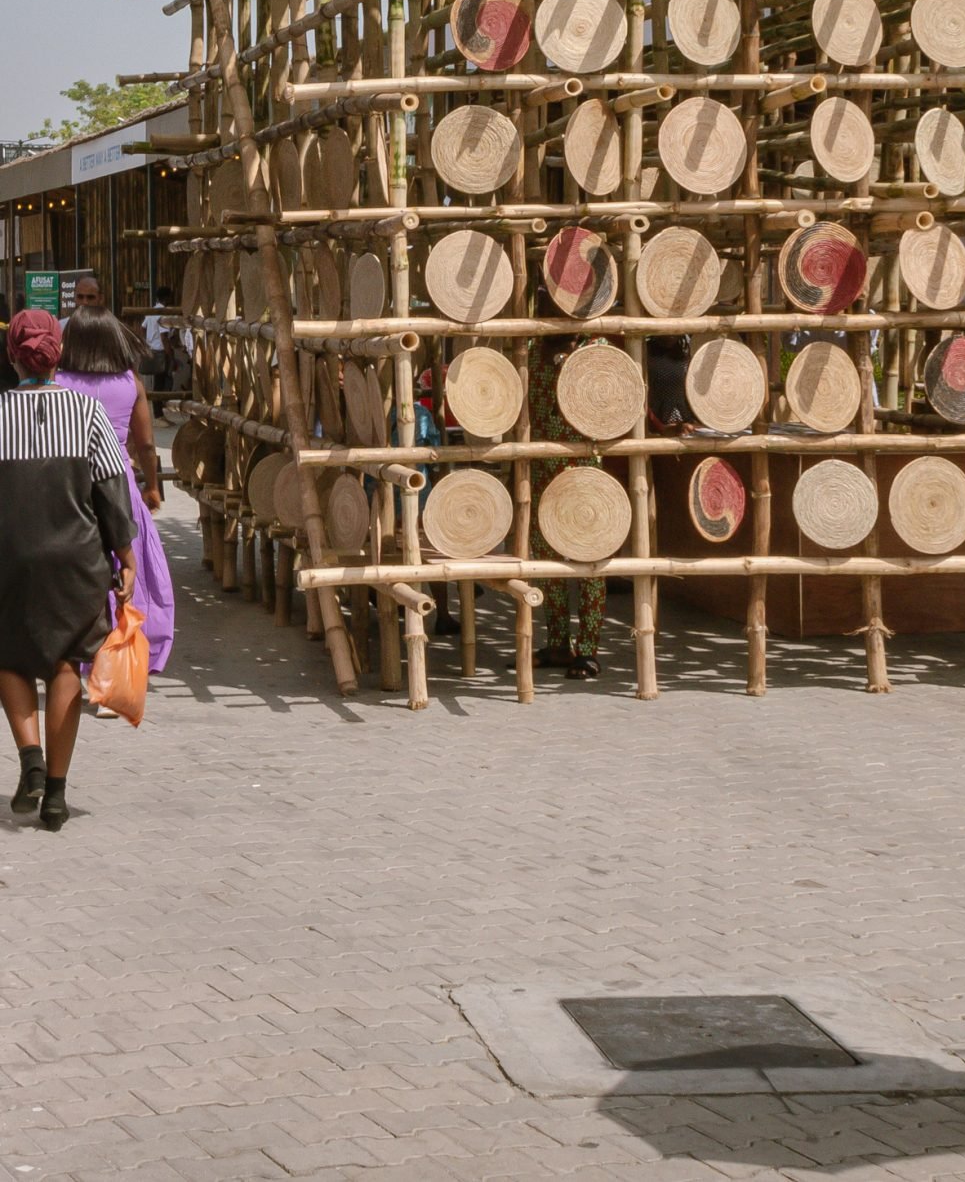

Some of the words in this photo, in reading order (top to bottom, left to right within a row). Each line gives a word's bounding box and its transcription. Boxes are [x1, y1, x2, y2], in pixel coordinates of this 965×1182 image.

[31, 276, 54, 284] AFUSAT
[61, 280, 76, 289] Good
[61, 291, 75, 299] Food
